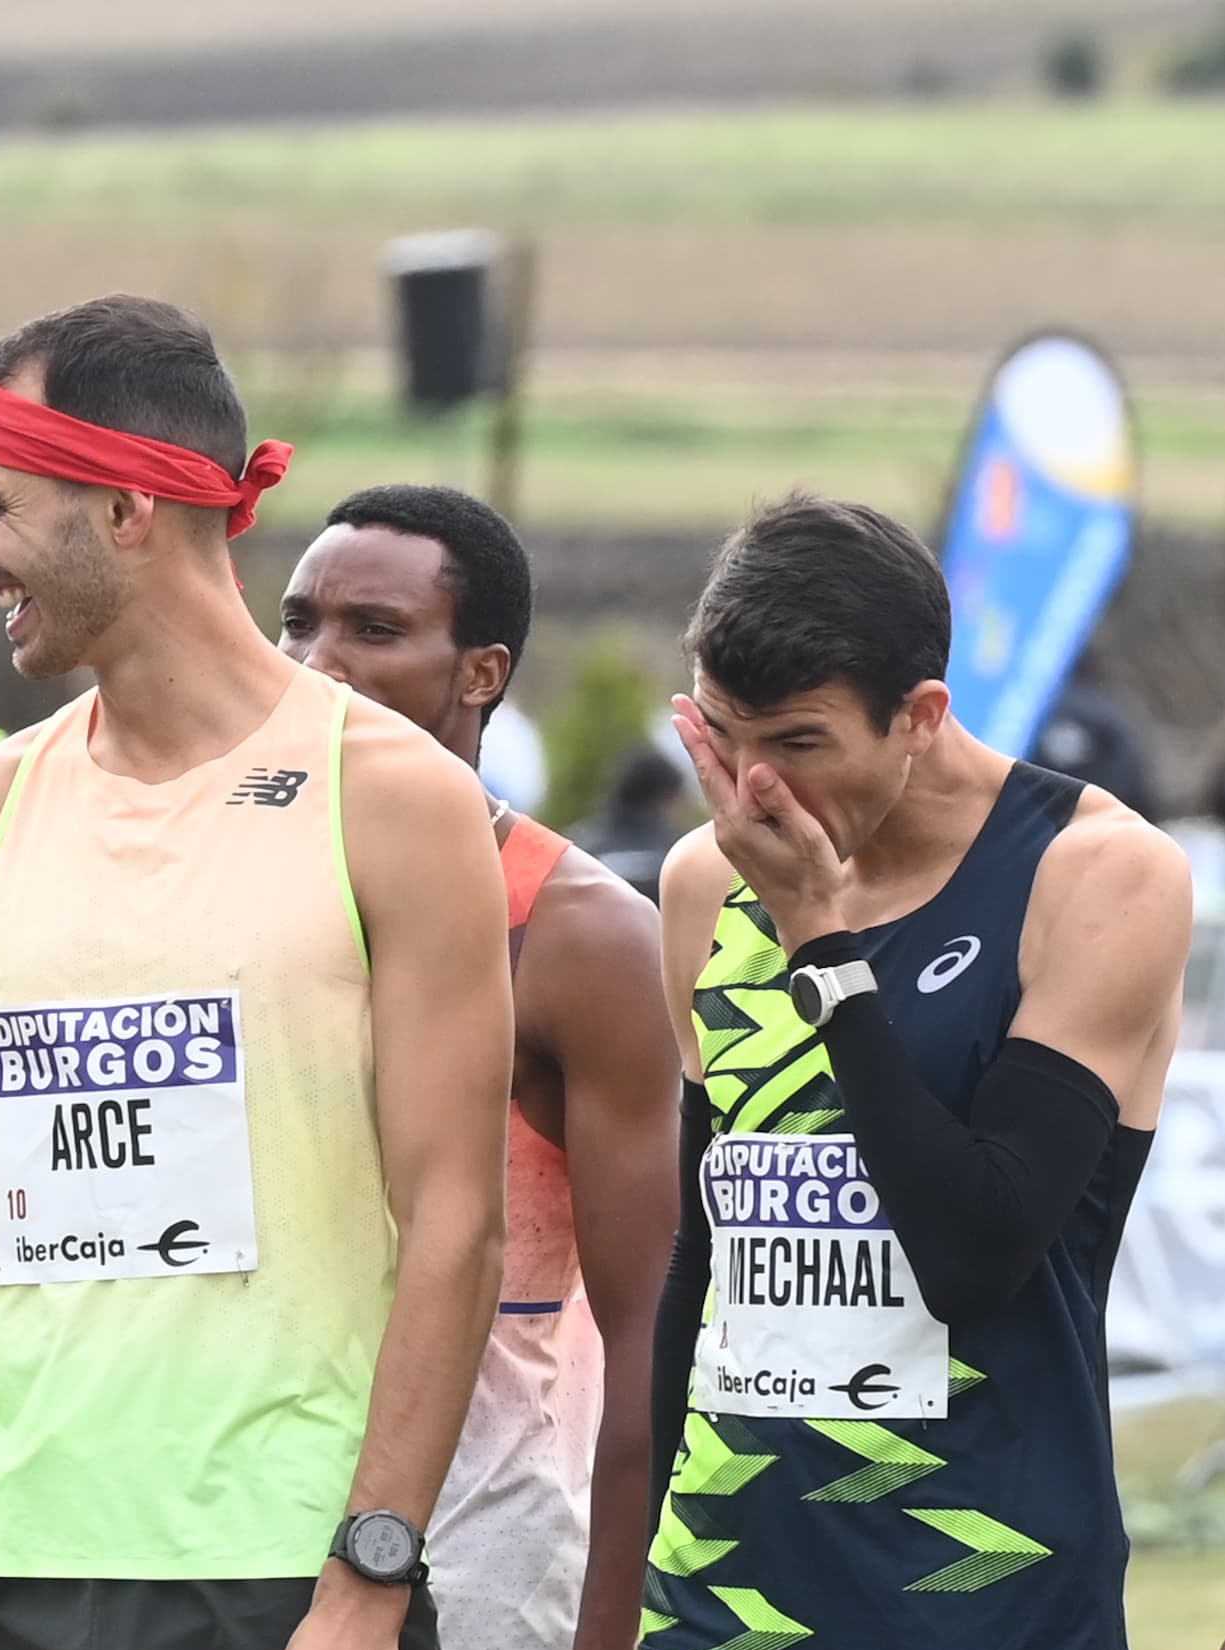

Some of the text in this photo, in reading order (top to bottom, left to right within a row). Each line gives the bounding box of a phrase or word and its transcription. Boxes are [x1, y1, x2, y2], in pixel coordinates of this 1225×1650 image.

[1, 1037, 223, 1092] BURGOS
[51, 1098, 155, 1171] ARCE
[710, 1144, 869, 1179] DIPUTACI
[7, 1189, 27, 1221] 10
[712, 1179, 879, 1224] BURGO
[16, 1232, 125, 1266] iberCaja
[729, 1237, 905, 1308] MECHAAL
[717, 1366, 816, 1403] iberCaja
